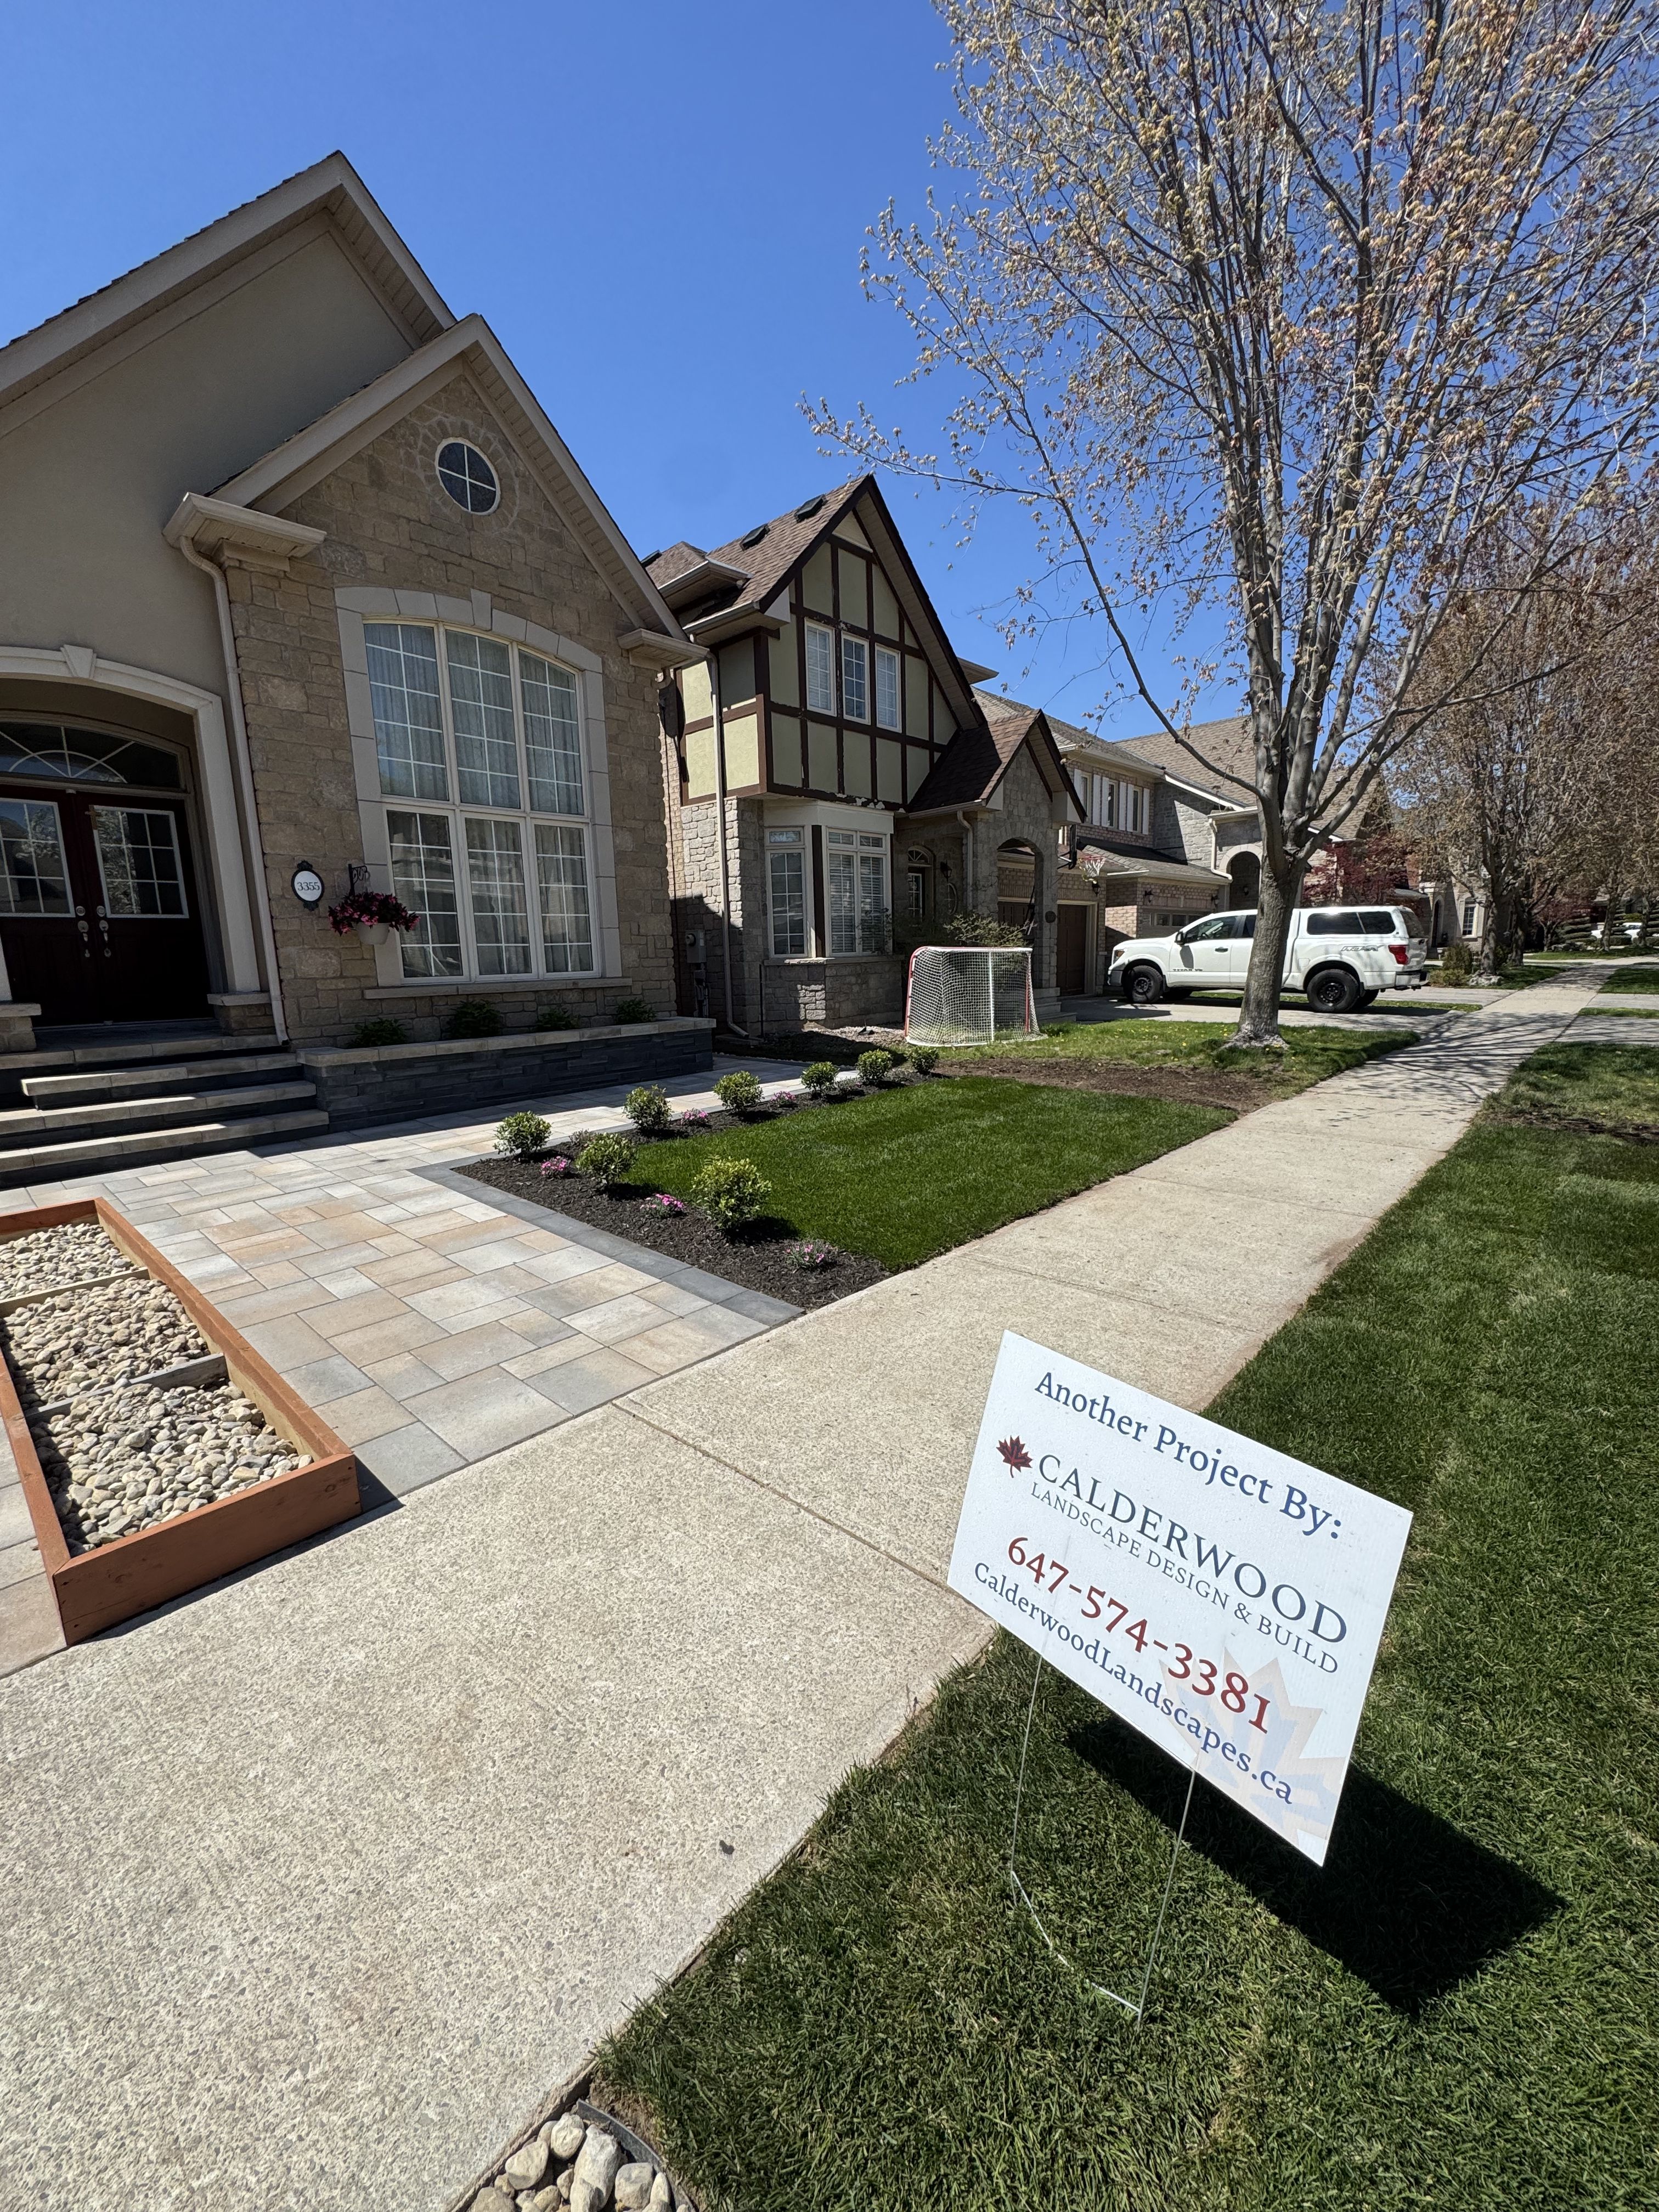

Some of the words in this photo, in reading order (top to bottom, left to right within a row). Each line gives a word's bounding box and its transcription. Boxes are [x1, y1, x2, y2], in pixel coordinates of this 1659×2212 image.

[297, 882, 320, 891] 3355
[1035, 1372, 1148, 1442] Another
[1154, 1425, 1273, 1503] Project
[1279, 1485, 1341, 1539] By:
[1040, 1455, 1346, 1643] CALDERWOOD
[1008, 1537, 1270, 1734] 647-574-3381
[1031, 1482, 1141, 1558] LANDSCAPE
[1147, 1549, 1229, 1610] DESIGN
[1234, 1603, 1251, 1624] &
[1257, 1615, 1338, 1673] BUILD
[975, 1563, 1292, 1804] CalderwoodLandscapes.ca
